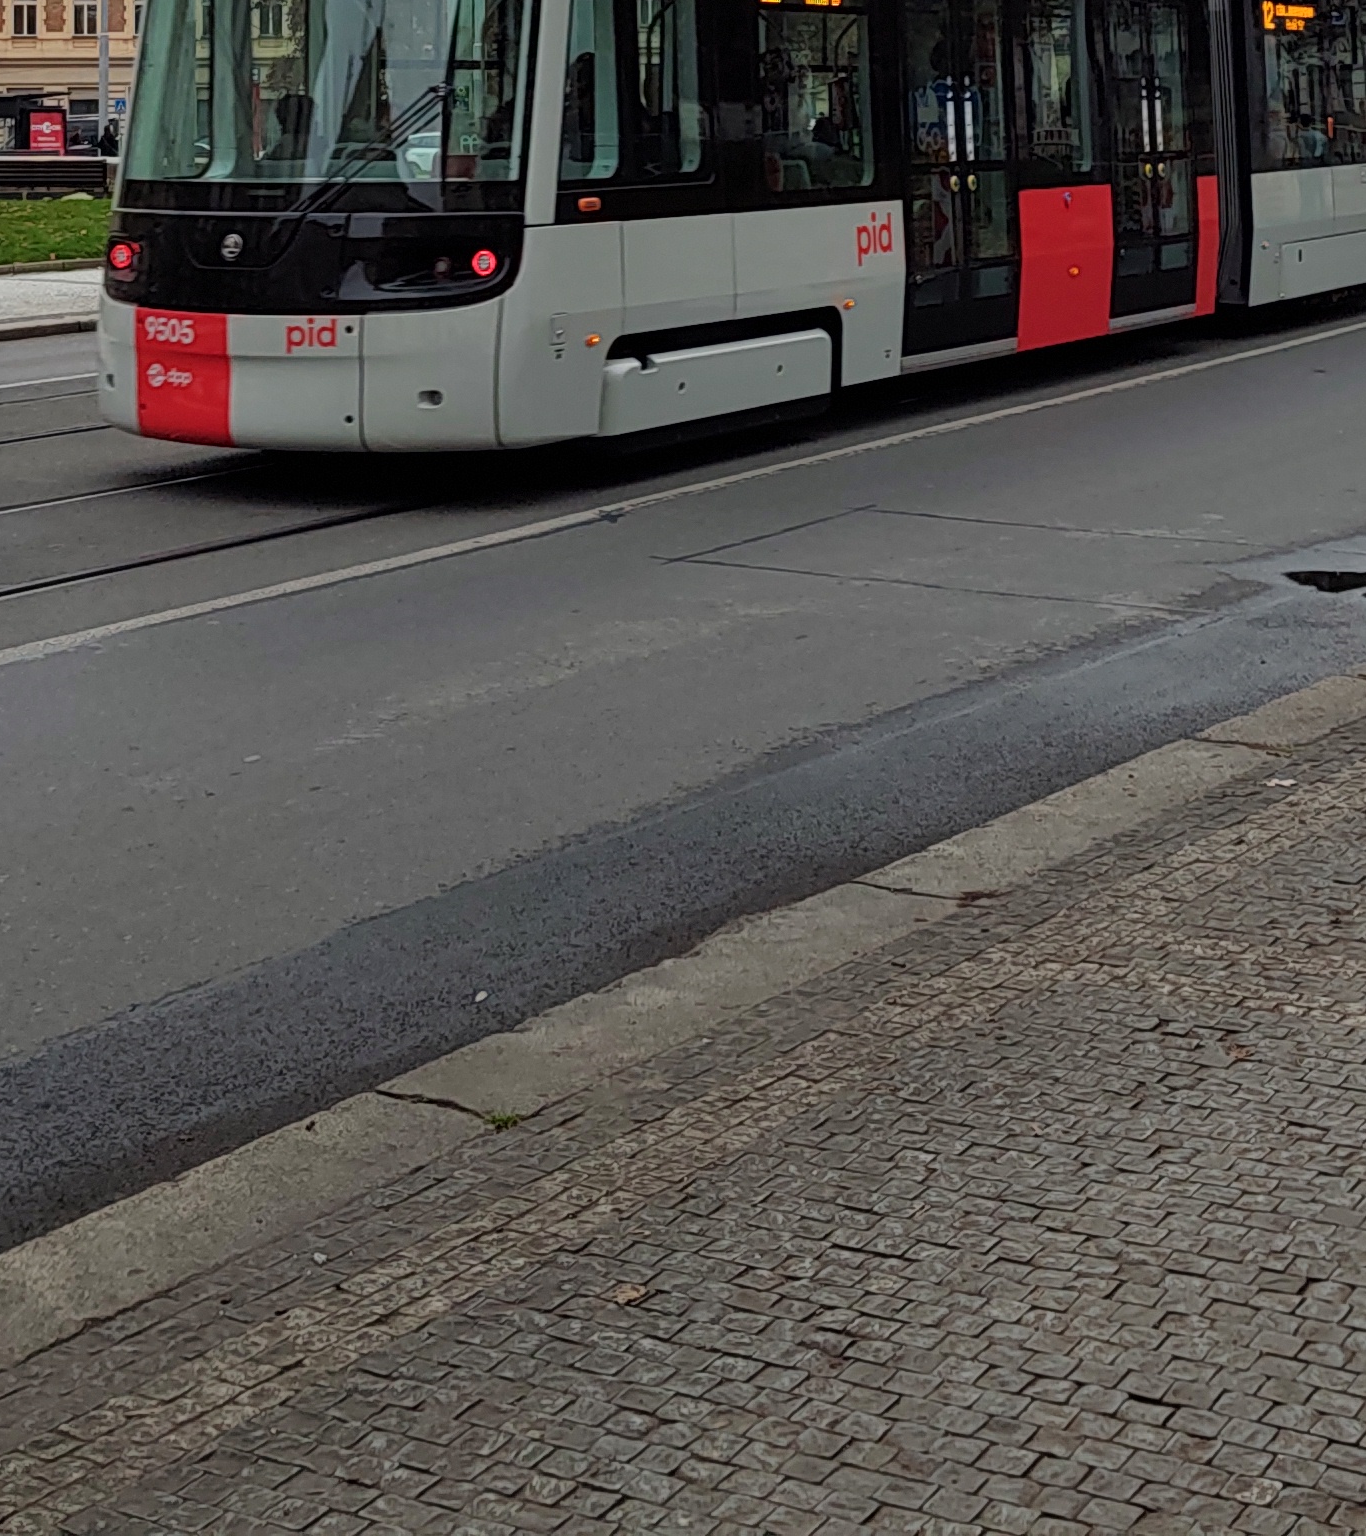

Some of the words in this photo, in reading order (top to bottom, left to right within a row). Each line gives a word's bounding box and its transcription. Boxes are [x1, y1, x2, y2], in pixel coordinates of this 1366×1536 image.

[857, 211, 893, 267] pid
[144, 316, 195, 345] 9505
[286, 318, 339, 354] pid
